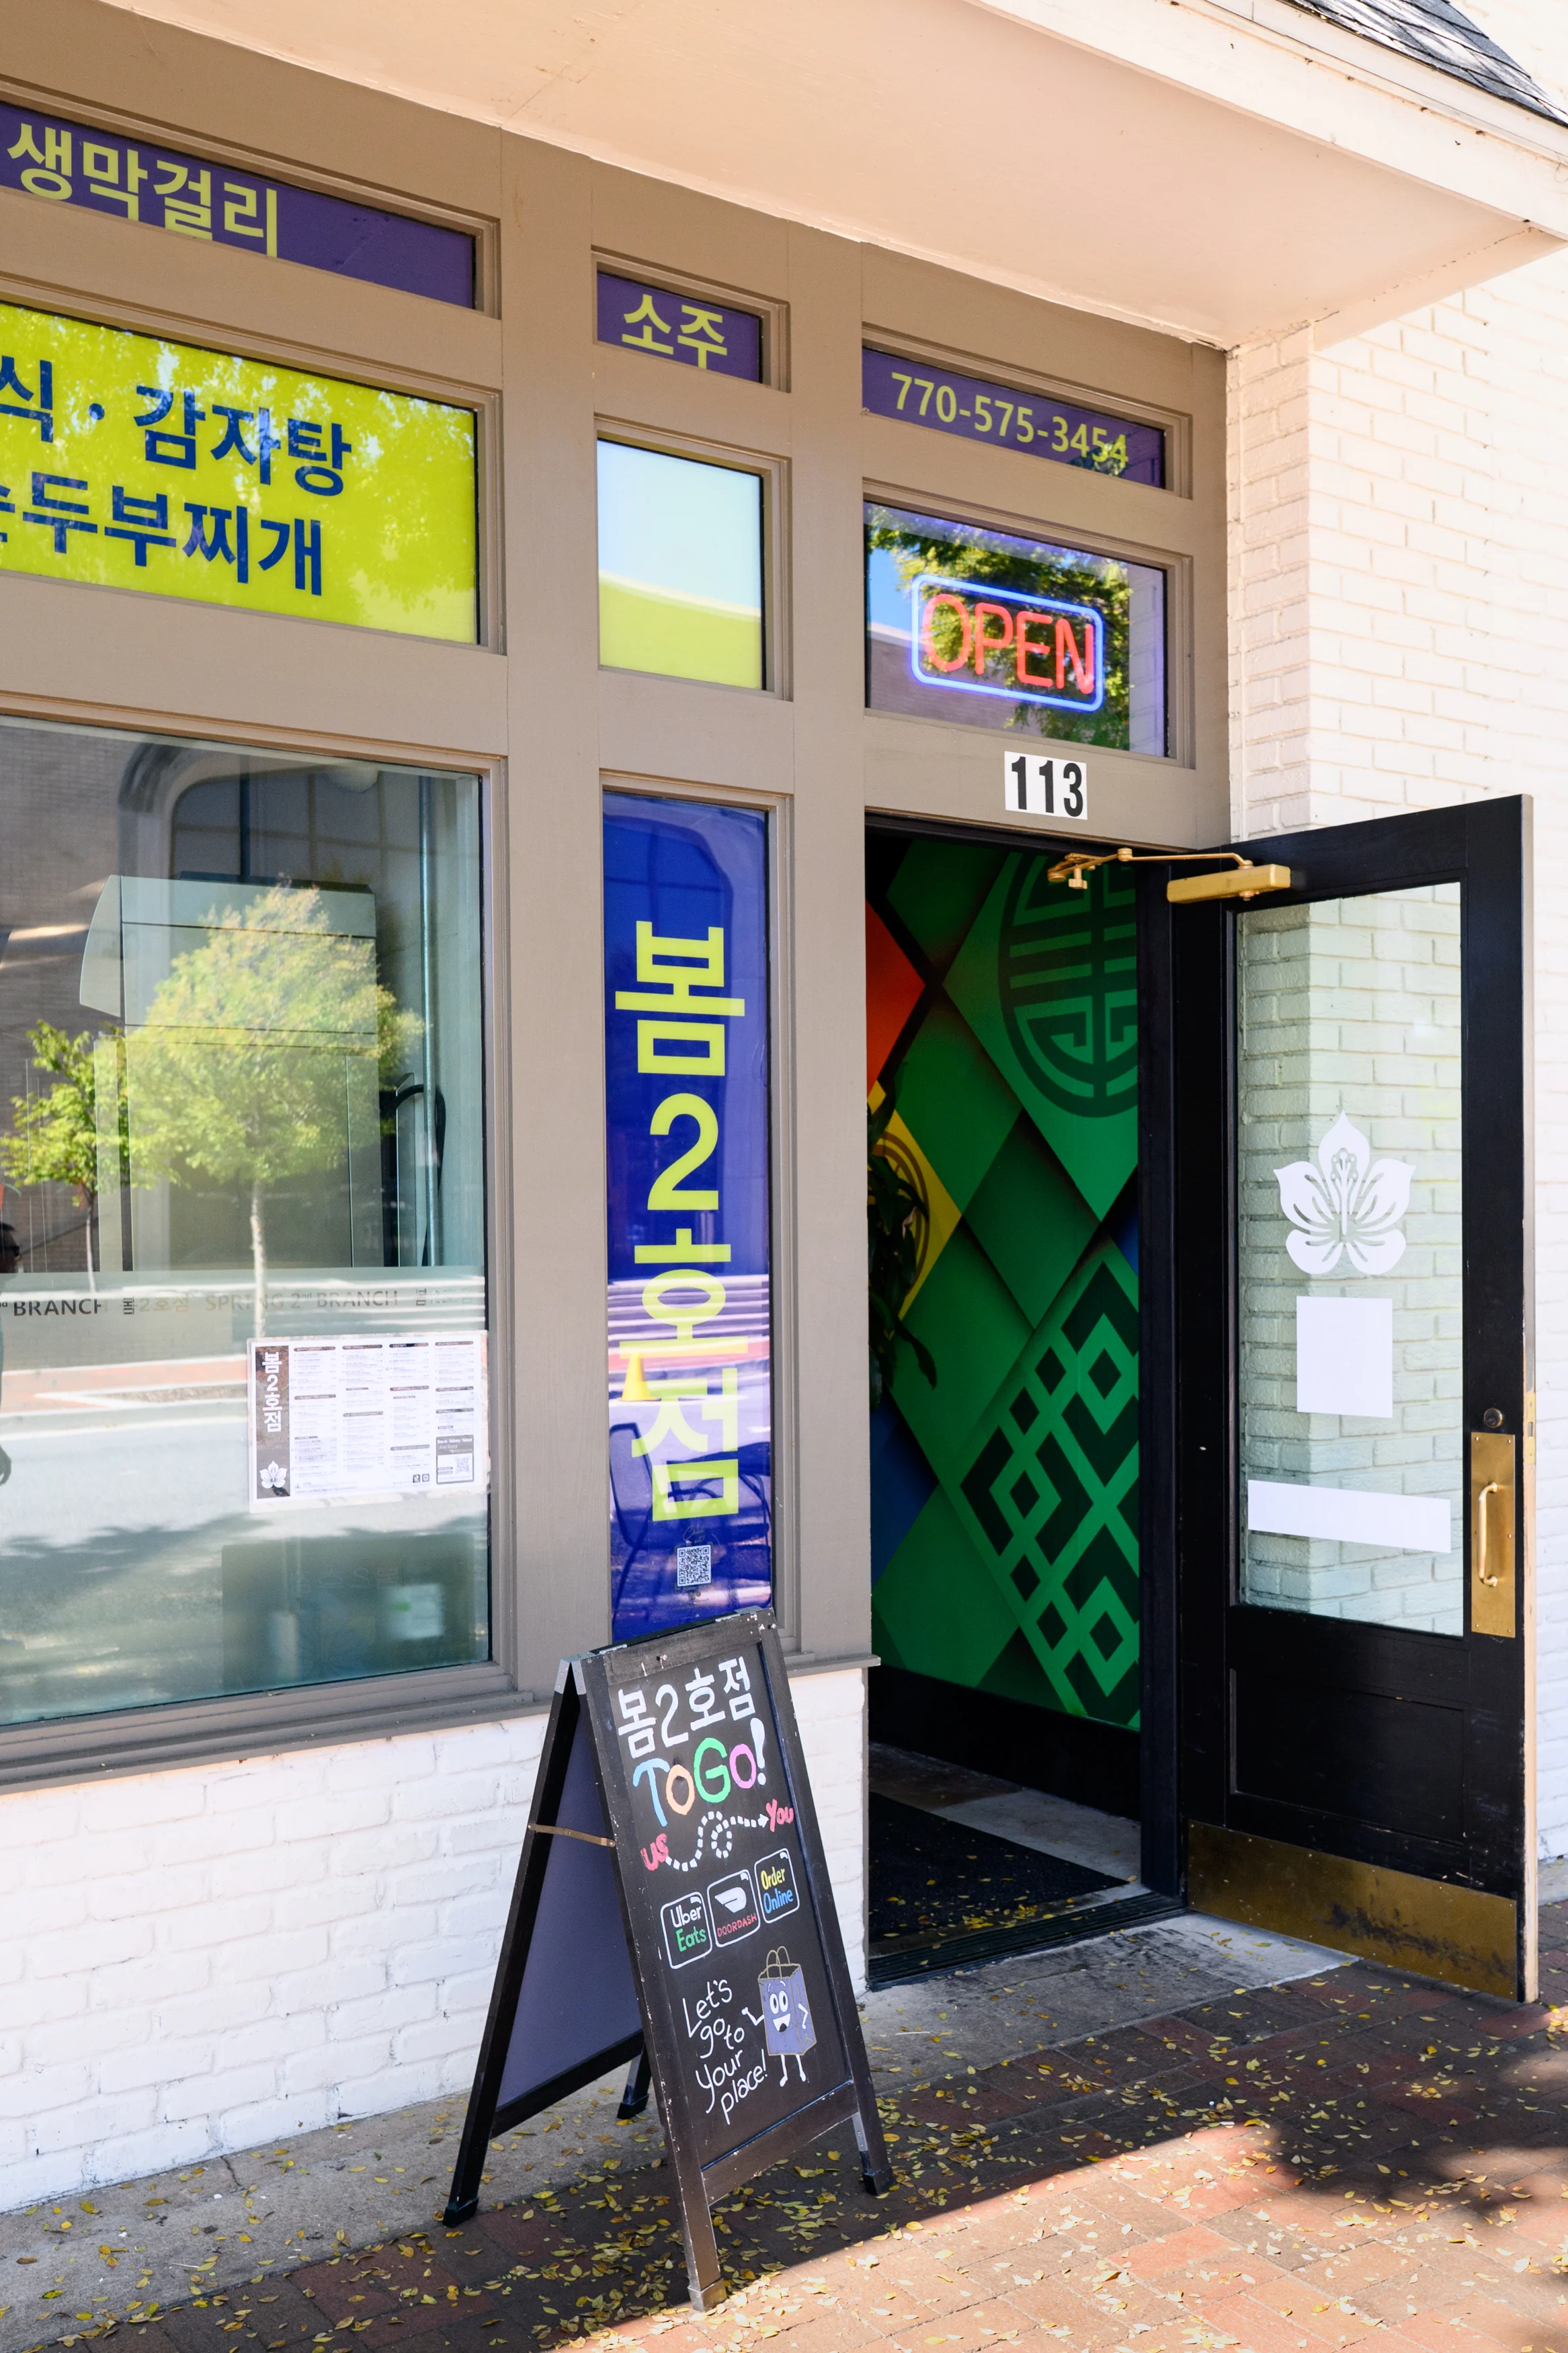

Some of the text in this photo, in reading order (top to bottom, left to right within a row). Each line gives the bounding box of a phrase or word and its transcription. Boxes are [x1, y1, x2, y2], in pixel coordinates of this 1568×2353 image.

[7, 123, 278, 258] 생막걸리
[622, 293, 729, 369] 소주
[134, 384, 352, 497] 감자탕
[891, 372, 1129, 469] 770-575-3454
[921, 592, 1095, 695] OPEN
[1012, 755, 1084, 818] 113
[616, 920, 748, 1522] 봄2호점
[317, 1289, 398, 1308] BRANCH
[261, 1351, 283, 1433] 봄2호점
[618, 1656, 755, 1759] 봄2호점
[761, 1867, 786, 1890] Order
[763, 1888, 794, 1914] Online
[670, 1905, 702, 1928] Uber
[675, 1925, 707, 1952] Eats
[717, 1913, 757, 1938] DOORDASH
[682, 1979, 733, 2038] Let's
[700, 2018, 745, 2059] go to
[720, 2048, 769, 2125] place!
